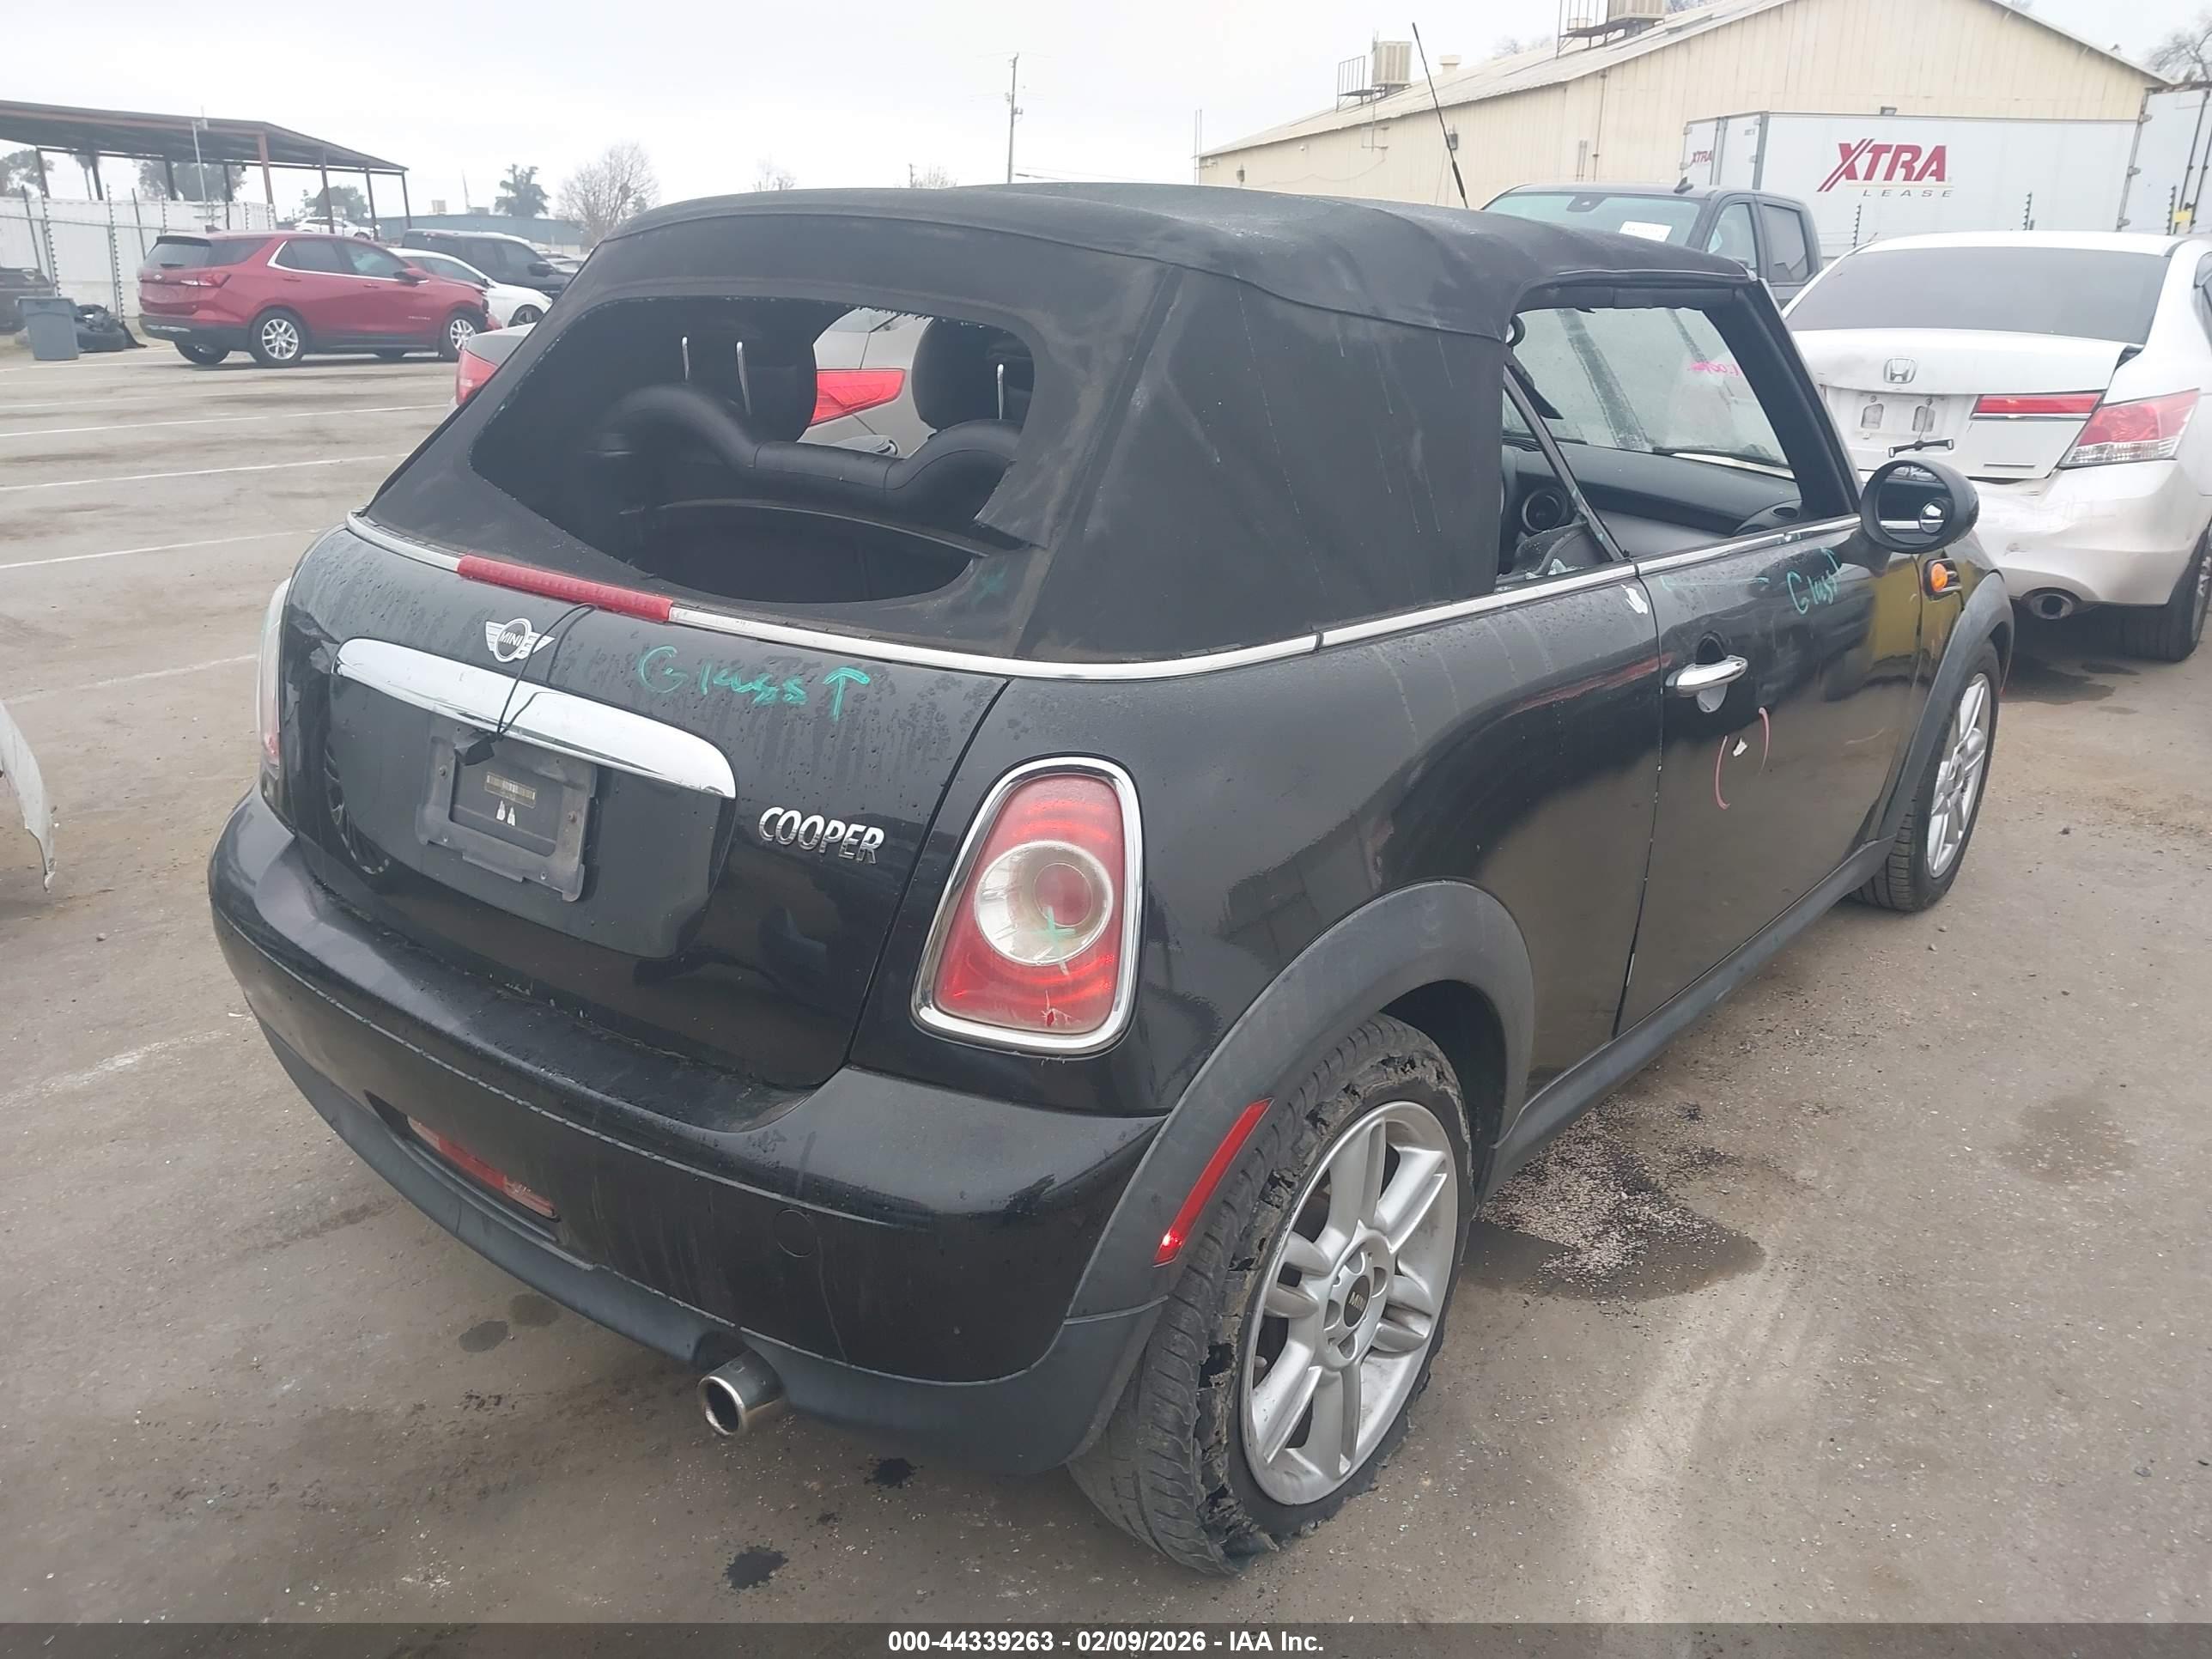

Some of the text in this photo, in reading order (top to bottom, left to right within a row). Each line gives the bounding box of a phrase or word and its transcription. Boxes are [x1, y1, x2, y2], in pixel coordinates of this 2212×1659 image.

[1816, 138, 1947, 192] XTRA
[1863, 189, 1954, 198] LEASE
[498, 631, 524, 647] MINI
[639, 646, 809, 705] Glass
[758, 806, 885, 865] COOPER
